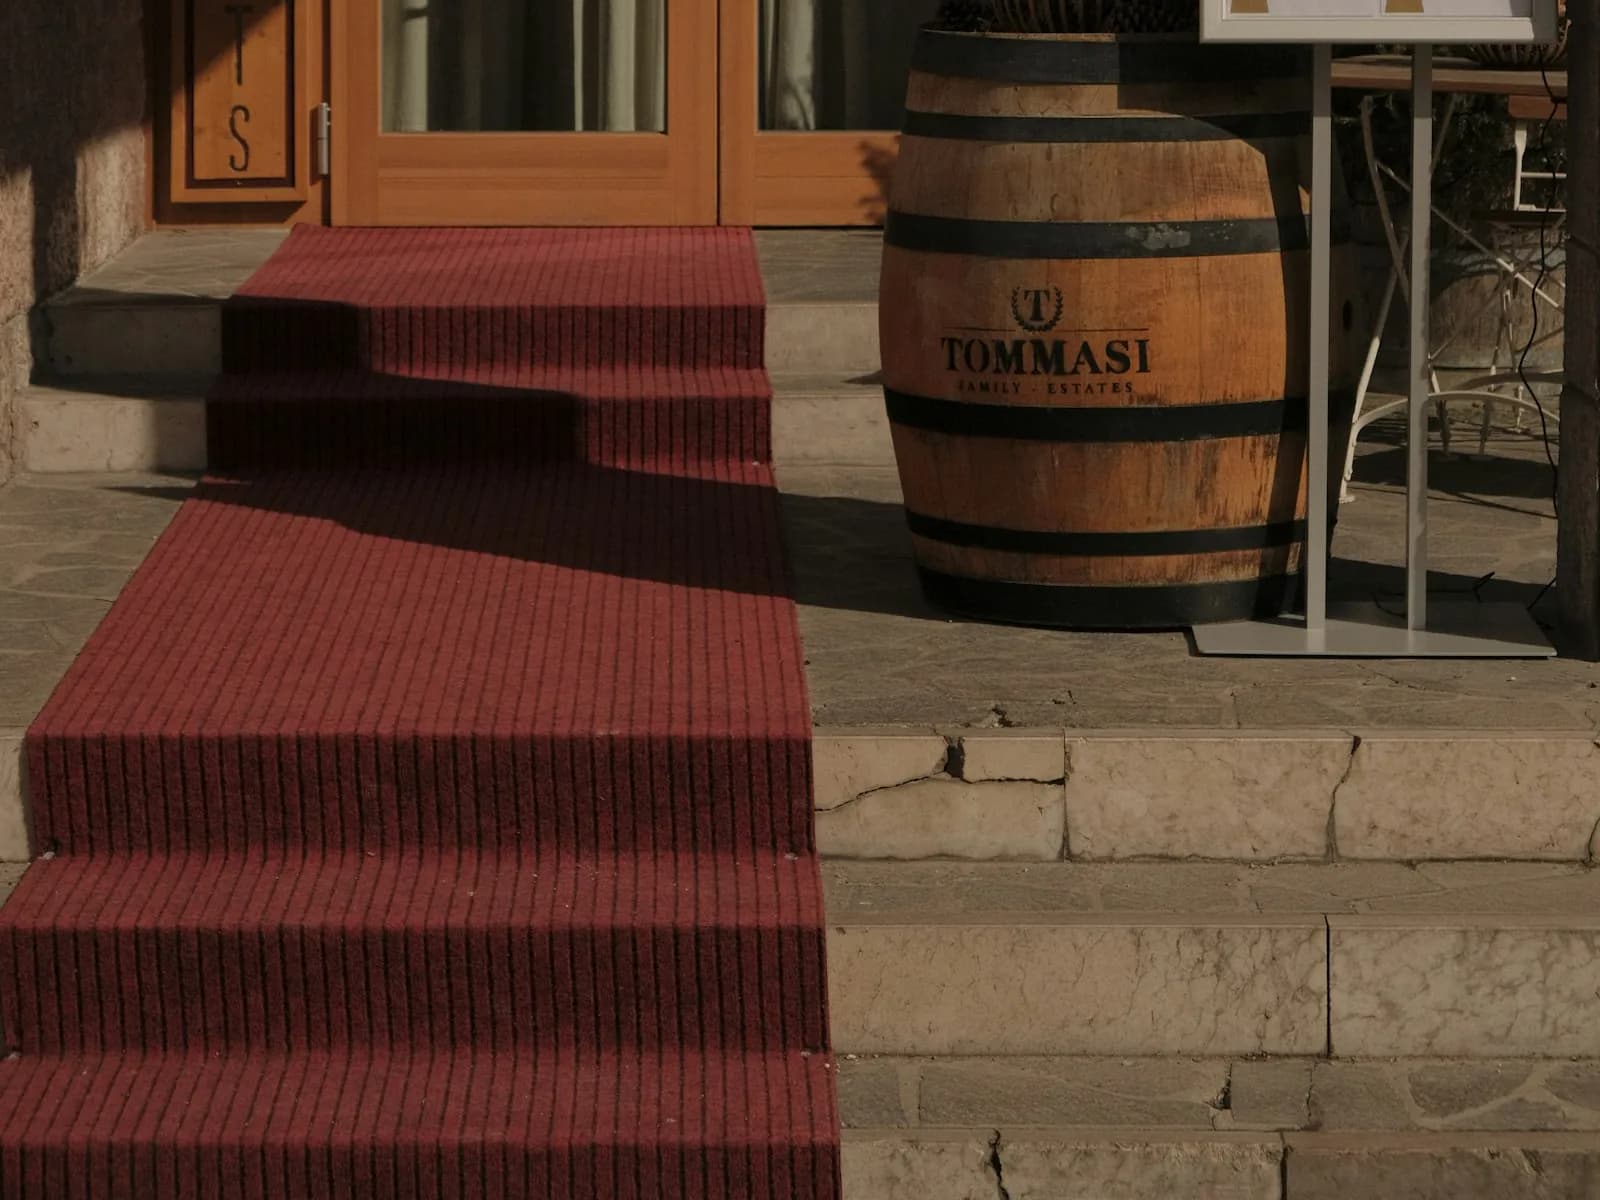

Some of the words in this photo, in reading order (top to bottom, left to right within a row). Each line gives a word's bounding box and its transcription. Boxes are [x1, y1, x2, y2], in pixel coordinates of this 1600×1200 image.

[1023, 289, 1050, 322] T
[941, 337, 1152, 377] TOMMASI
[958, 380, 1021, 394] FAMILY
[1047, 382, 1134, 395] ESTATES
